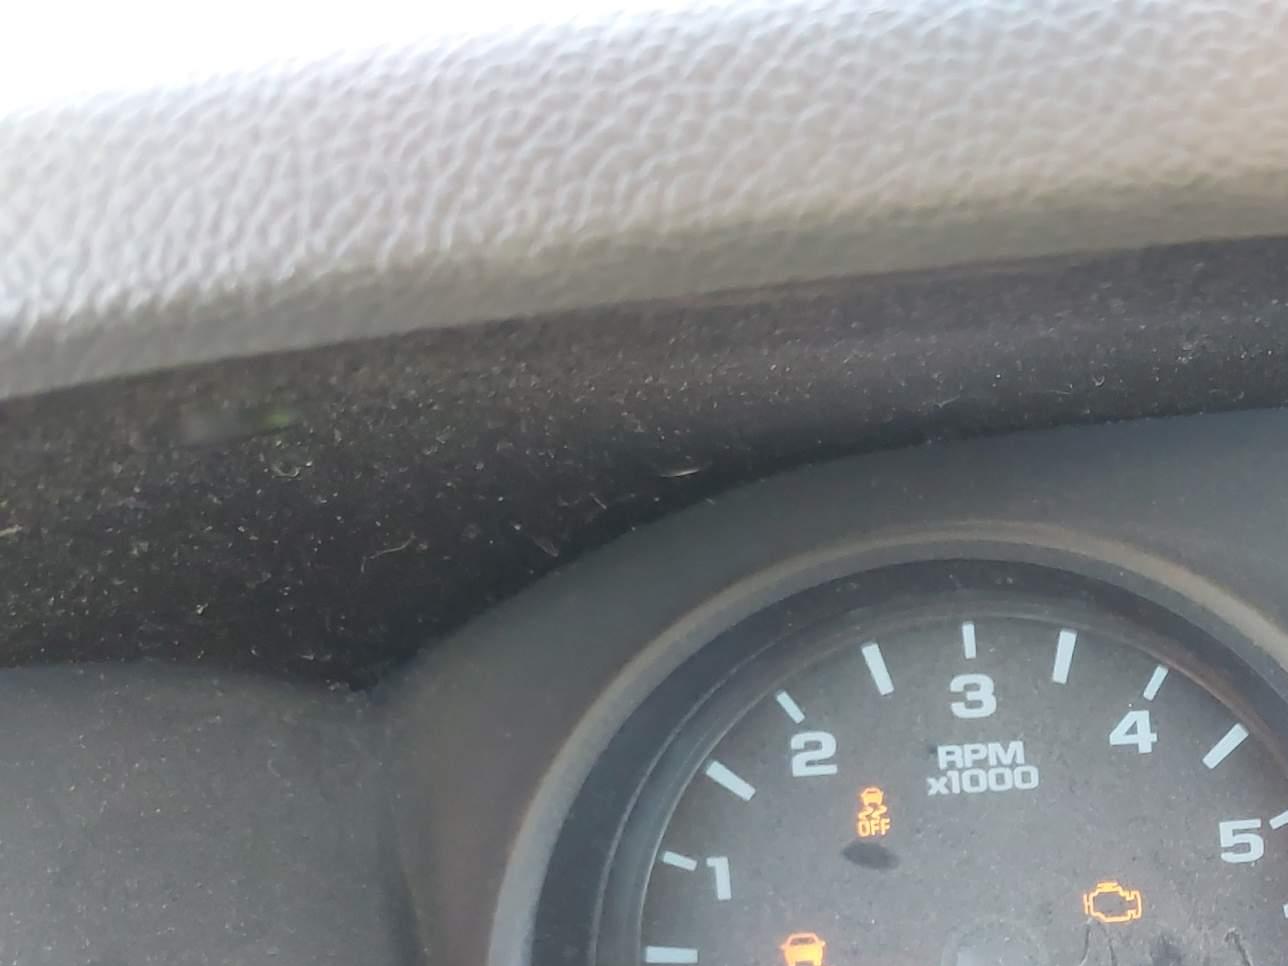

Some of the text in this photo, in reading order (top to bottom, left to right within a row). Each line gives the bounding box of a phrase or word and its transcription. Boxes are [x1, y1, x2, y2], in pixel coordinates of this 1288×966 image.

[950, 673, 997, 719] 3
[790, 731, 838, 777] 2
[1109, 710, 1157, 754] 4
[937, 740, 1025, 770] RPM
[927, 765, 1039, 796] x1000
[857, 818, 890, 837] OFF
[1218, 818, 1265, 863] 5
[706, 856, 732, 900] 1
